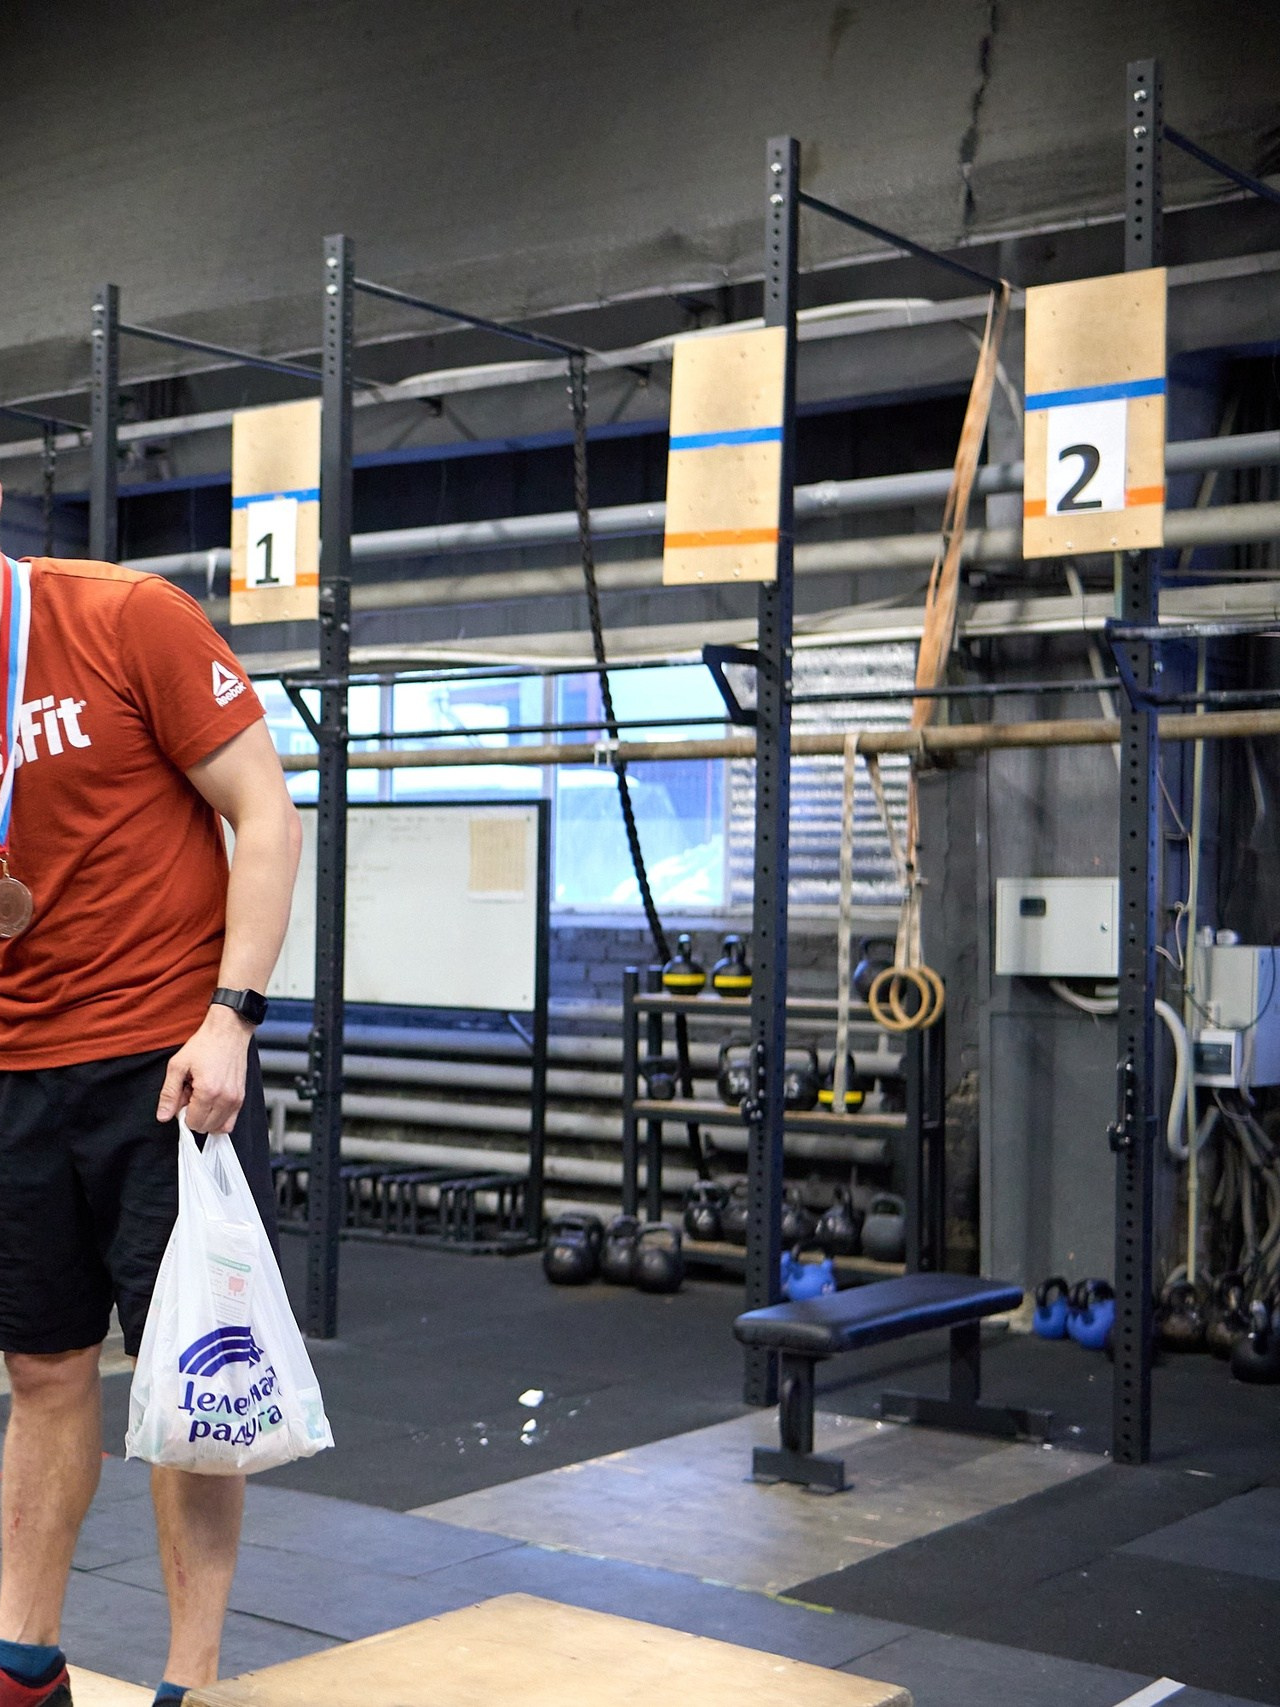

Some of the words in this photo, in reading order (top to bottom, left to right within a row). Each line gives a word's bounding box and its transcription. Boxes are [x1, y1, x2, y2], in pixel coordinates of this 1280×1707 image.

[1056, 443, 1102, 512] 2
[255, 532, 280, 584] 1
[215, 681, 247, 708] Reebok
[188, 1404, 283, 1447] радуга
